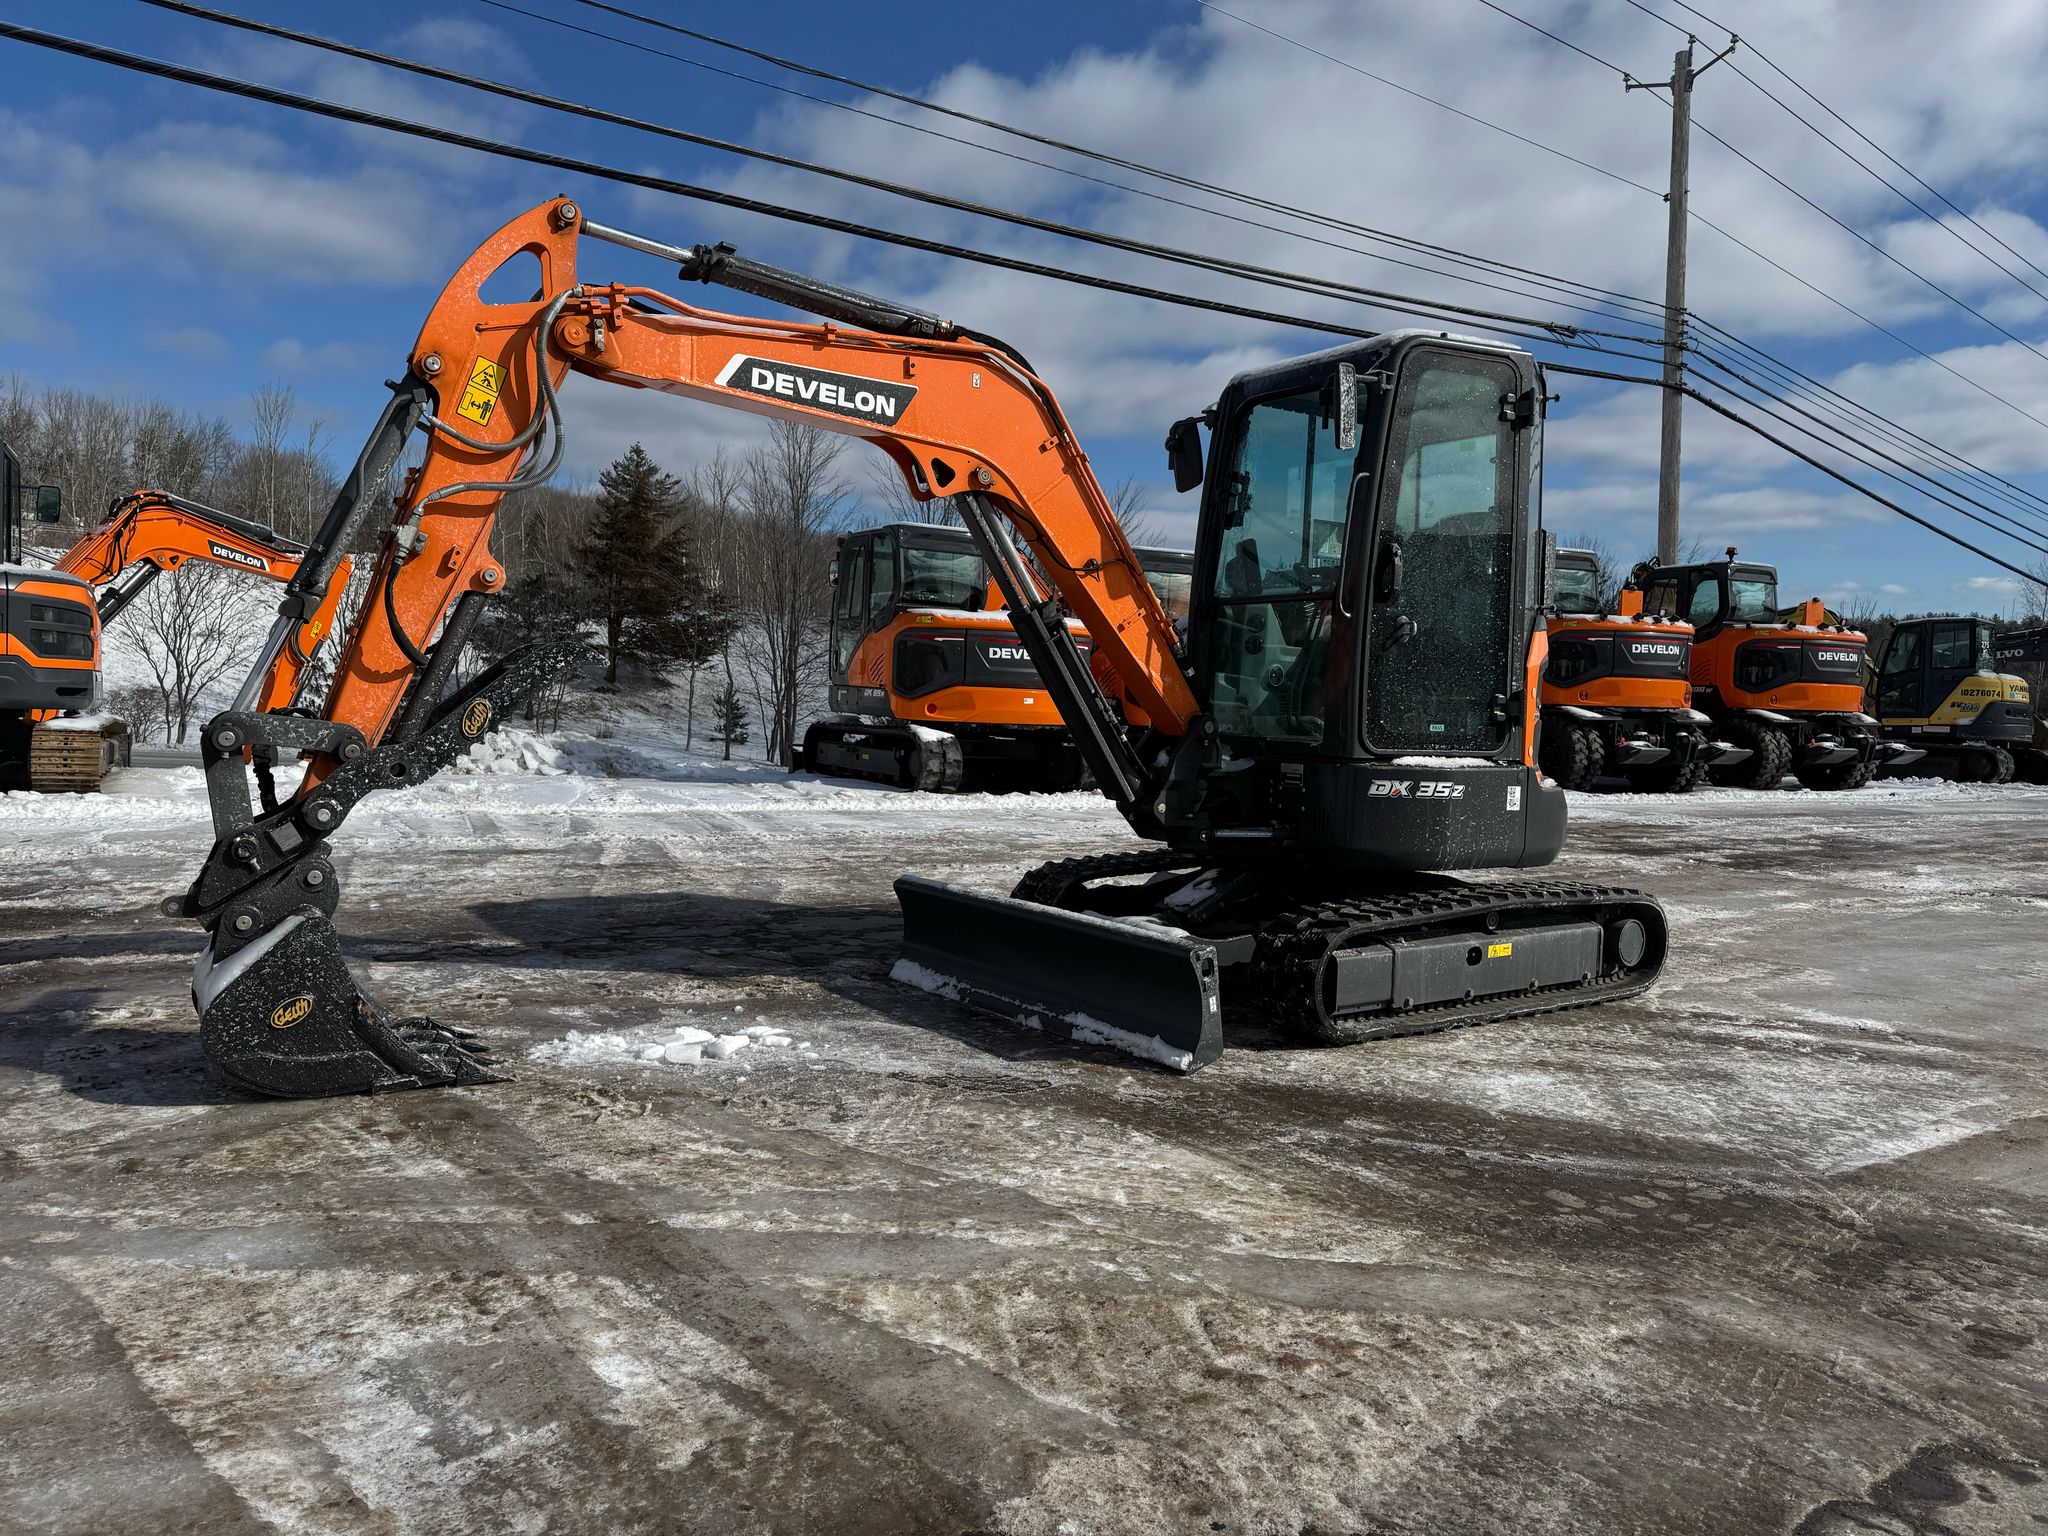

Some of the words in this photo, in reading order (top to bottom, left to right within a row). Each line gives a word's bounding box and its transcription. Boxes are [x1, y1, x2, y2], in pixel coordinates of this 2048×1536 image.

[751, 366, 896, 418] DEVELON
[213, 545, 261, 568] DEVELON
[989, 647, 1031, 660] DEVE
[1631, 644, 1680, 655] DEVELON
[1995, 648, 2025, 659] LVO
[1818, 652, 1858, 662] DEVELON
[2009, 684, 2029, 693] YANM
[1368, 779, 1414, 798] DX
